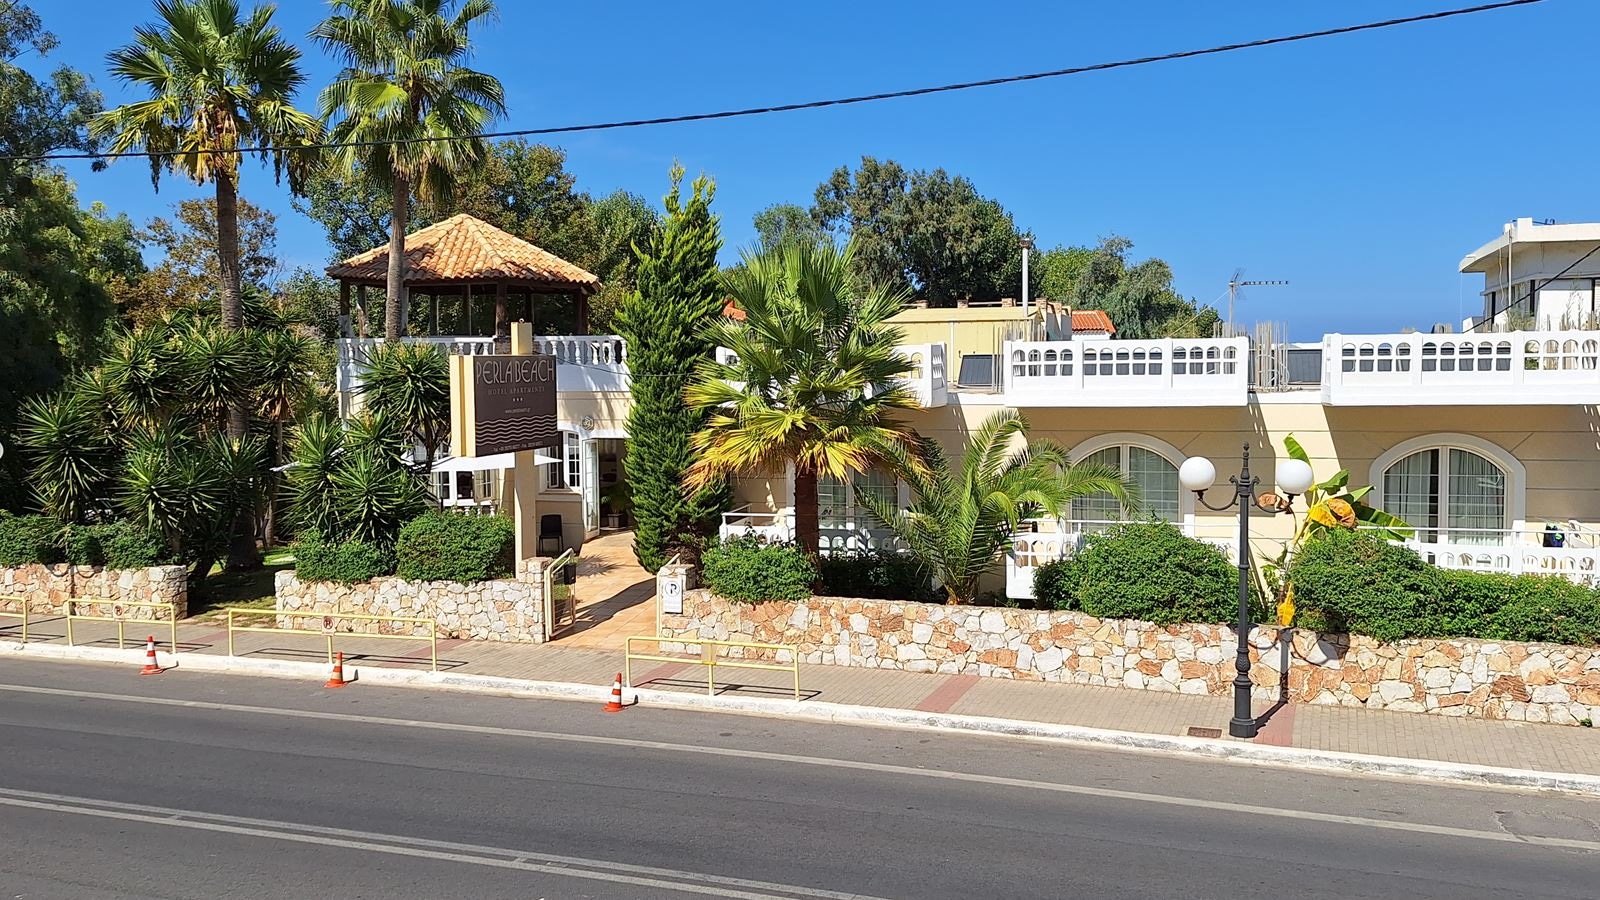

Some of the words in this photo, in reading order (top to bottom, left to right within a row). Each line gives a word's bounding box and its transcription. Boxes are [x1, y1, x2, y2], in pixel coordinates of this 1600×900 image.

[476, 361, 513, 384] PERLA
[515, 360, 554, 382] BEACH
[488, 387, 508, 395] HOTEL
